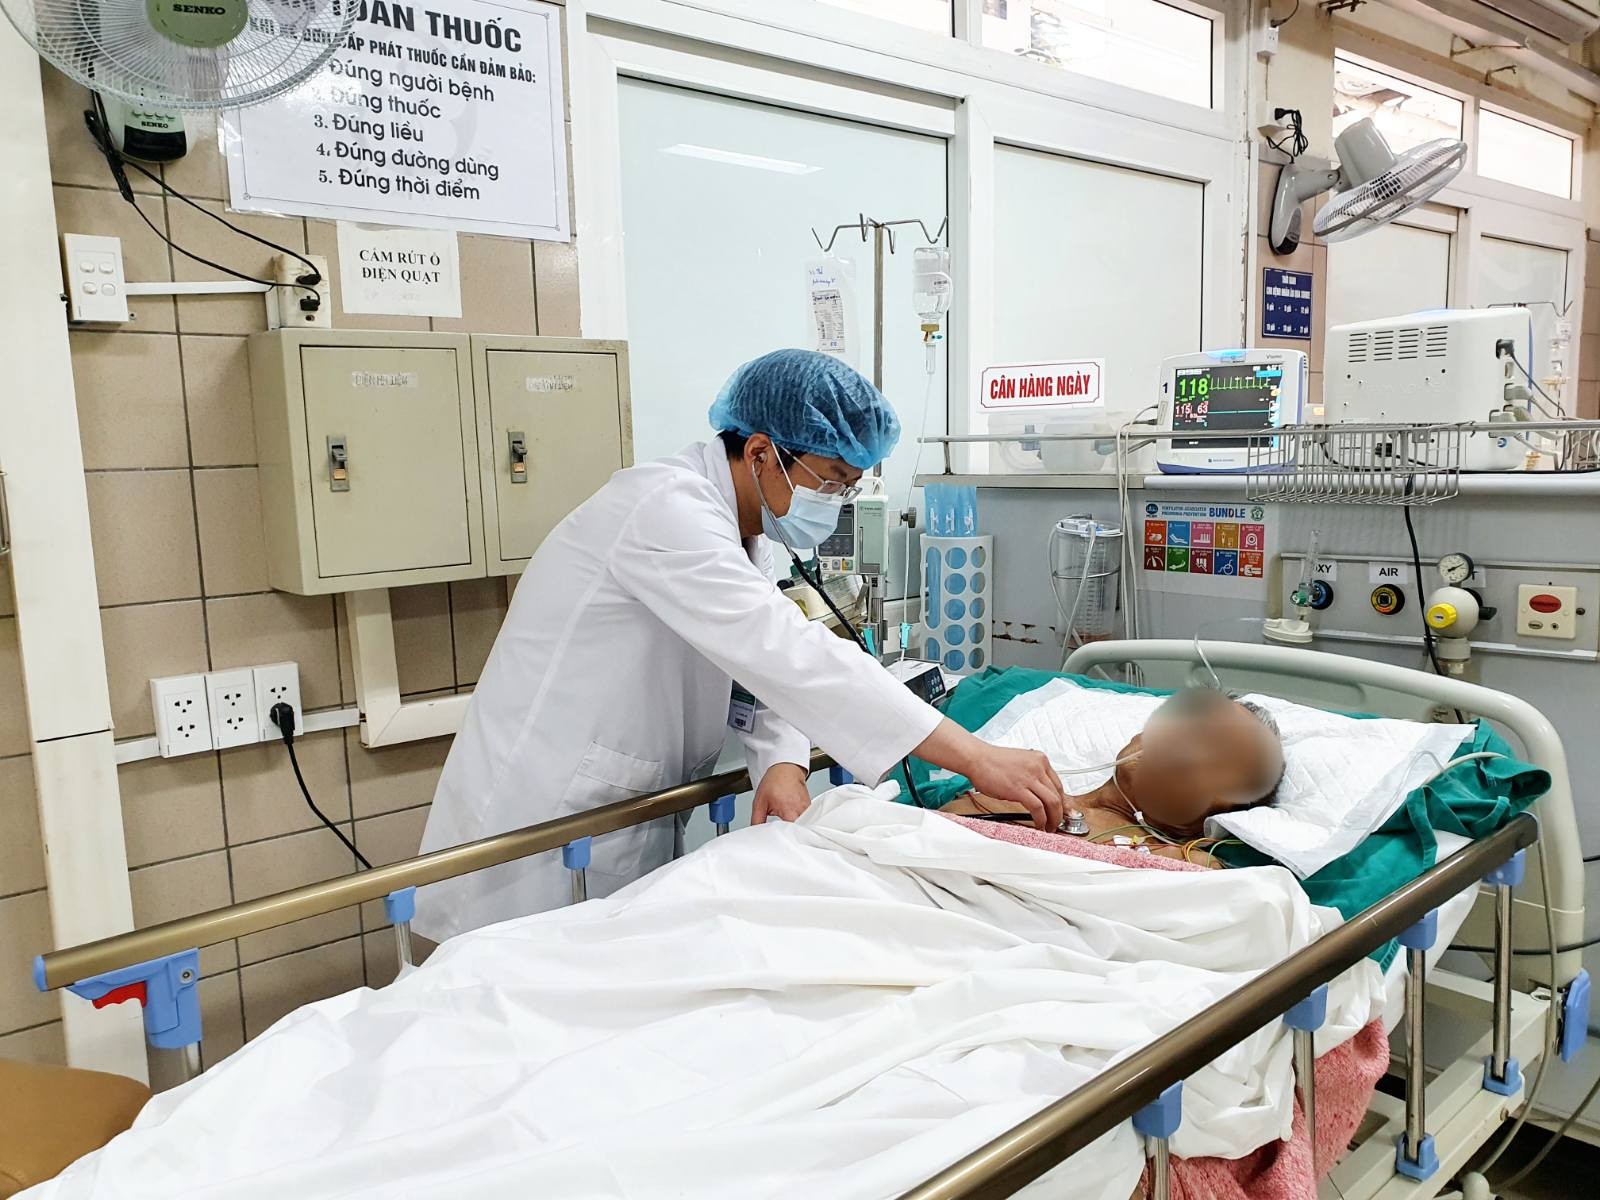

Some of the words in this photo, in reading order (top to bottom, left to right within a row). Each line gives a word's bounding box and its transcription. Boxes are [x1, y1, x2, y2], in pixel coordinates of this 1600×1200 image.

[172, 4, 226, 15] SENKO
[424, 10, 522, 52] THUỐC
[370, 40, 402, 58] PHÁT
[407, 47, 447, 68] THUỐC
[480, 57, 506, 78] ĐẢM
[510, 63, 536, 83] BẢO:
[329, 58, 383, 87] Đúng
[390, 72, 443, 92] người
[449, 79, 494, 102] bệnh
[388, 95, 441, 118] thuốc
[314, 114, 328, 128] 3.
[332, 113, 384, 140] Đúng
[391, 121, 424, 142] liều
[335, 141, 386, 167] Đúng
[392, 149, 450, 175] đường
[455, 157, 499, 180] dùng
[318, 170, 332, 184] 5.
[339, 168, 390, 194] Đúng
[396, 175, 429, 195] thời
[436, 178, 480, 200] điểm
[401, 270, 441, 285] QUẠT
[990, 374, 1016, 400] CÂN
[1019, 373, 1053, 398] HÀNG
[1056, 370, 1091, 396] NGÀY
[1162, 382, 1168, 394] 1
[1179, 378, 1208, 396] 118
[1209, 507, 1246, 519] BUNDLE
[1315, 564, 1332, 573] XY
[1379, 567, 1399, 577] AIR
